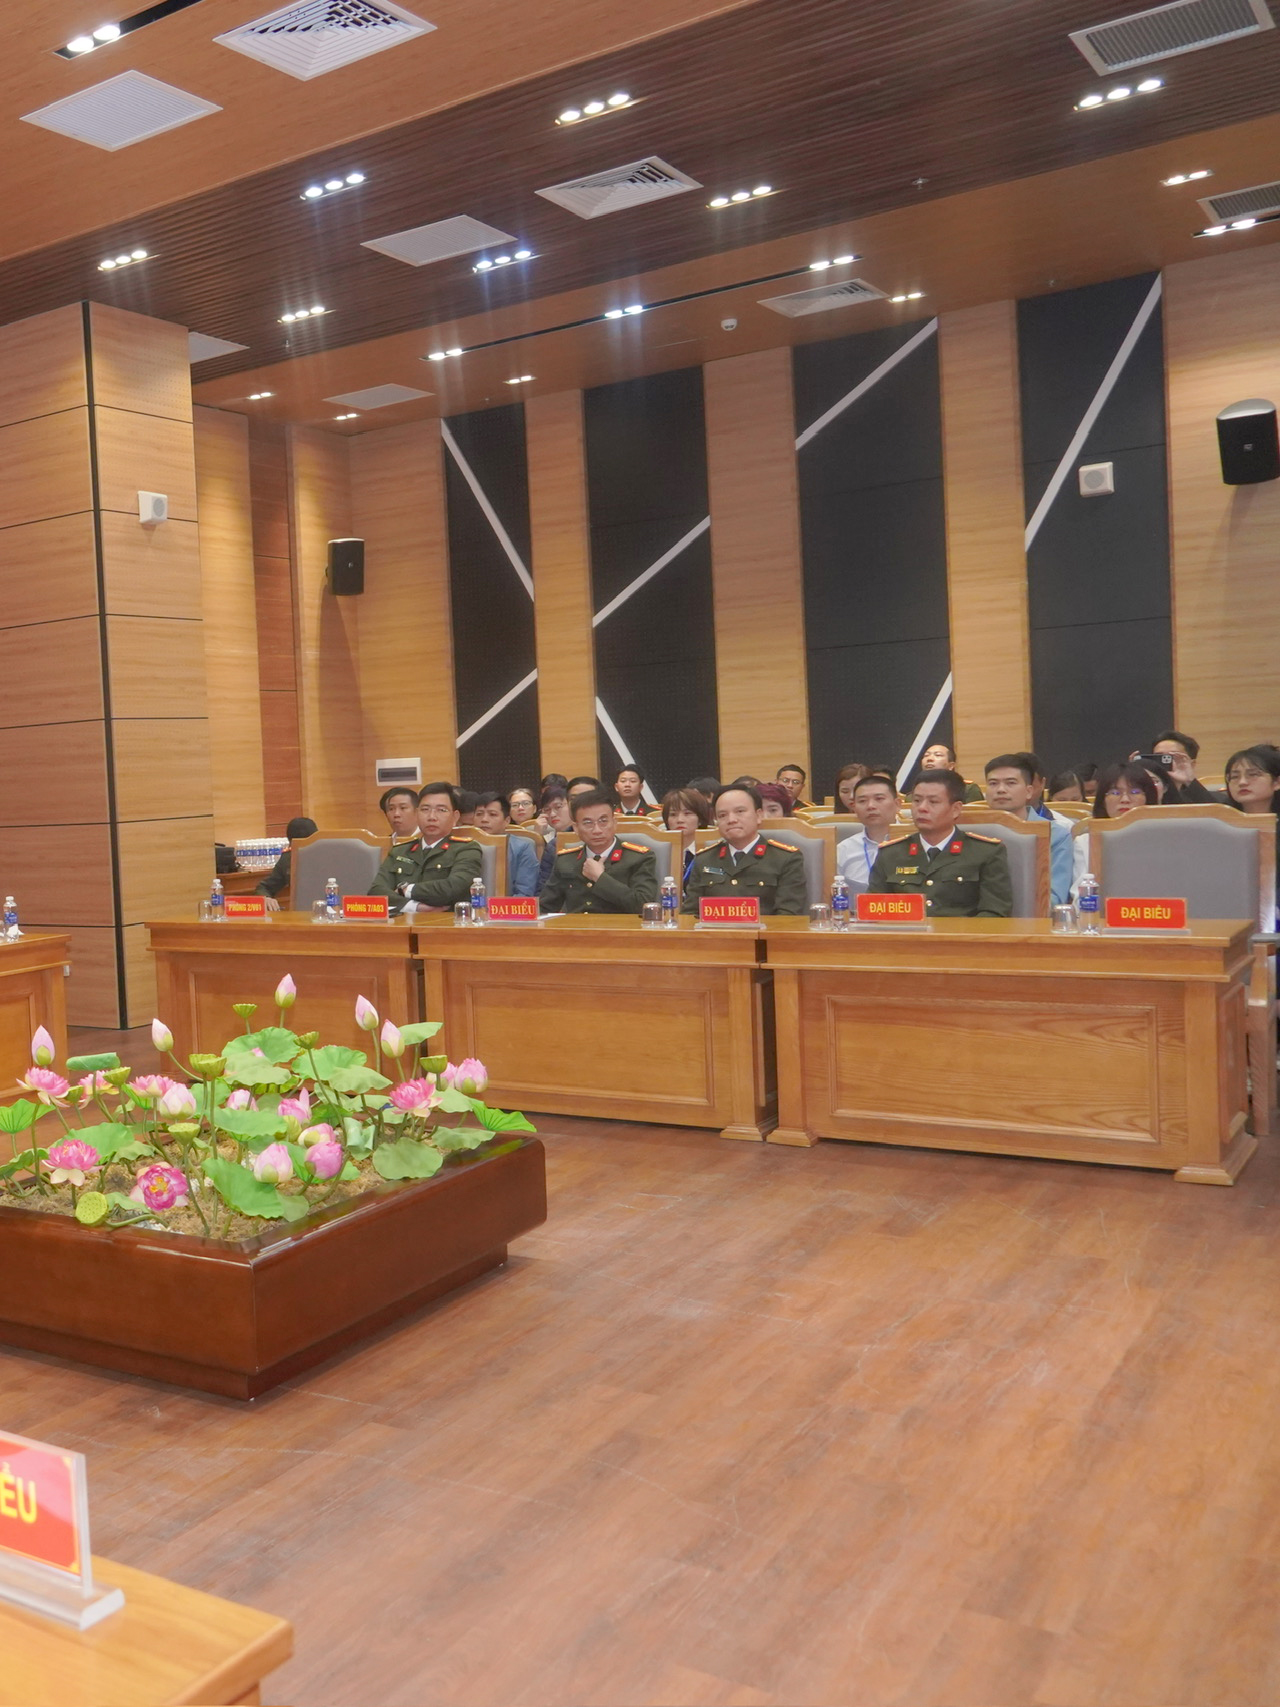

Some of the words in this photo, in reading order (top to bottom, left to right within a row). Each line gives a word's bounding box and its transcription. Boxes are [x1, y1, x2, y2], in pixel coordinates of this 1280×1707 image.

[491, 904, 509, 917] ĐẠI
[511, 900, 535, 915] BIỂU
[704, 905, 725, 919] ĐẠI
[728, 901, 756, 917] BIỂU
[869, 902, 886, 916] ĐẠI
[1120, 906, 1141, 921] ĐẠI
